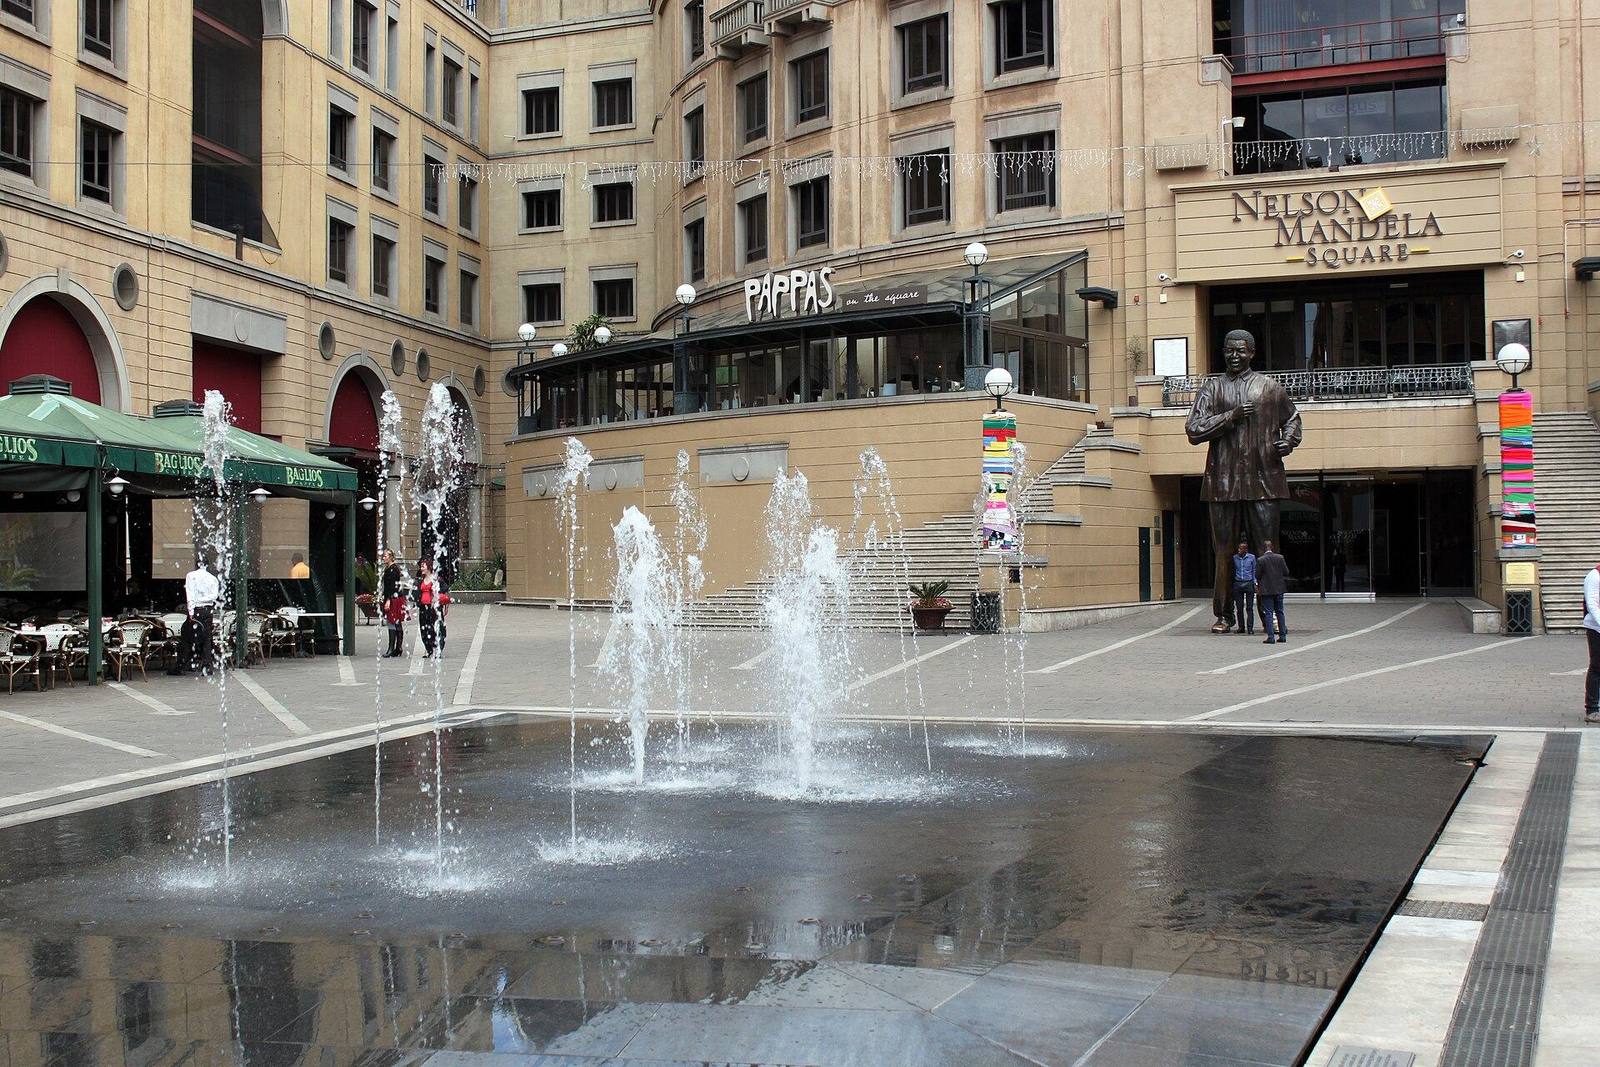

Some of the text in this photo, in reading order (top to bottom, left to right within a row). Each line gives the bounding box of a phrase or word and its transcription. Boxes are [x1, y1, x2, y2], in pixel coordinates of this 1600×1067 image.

[1232, 188, 1366, 222] NELSON
[1275, 211, 1443, 247] MANDELA
[1306, 243, 1408, 268] SQUARE
[744, 266, 836, 322] PAPPAS
[864, 293, 879, 303] the
[884, 291, 919, 304] square
[154, 452, 203, 478] BAGLIOS
[285, 466, 323, 487] BAGLIOS
